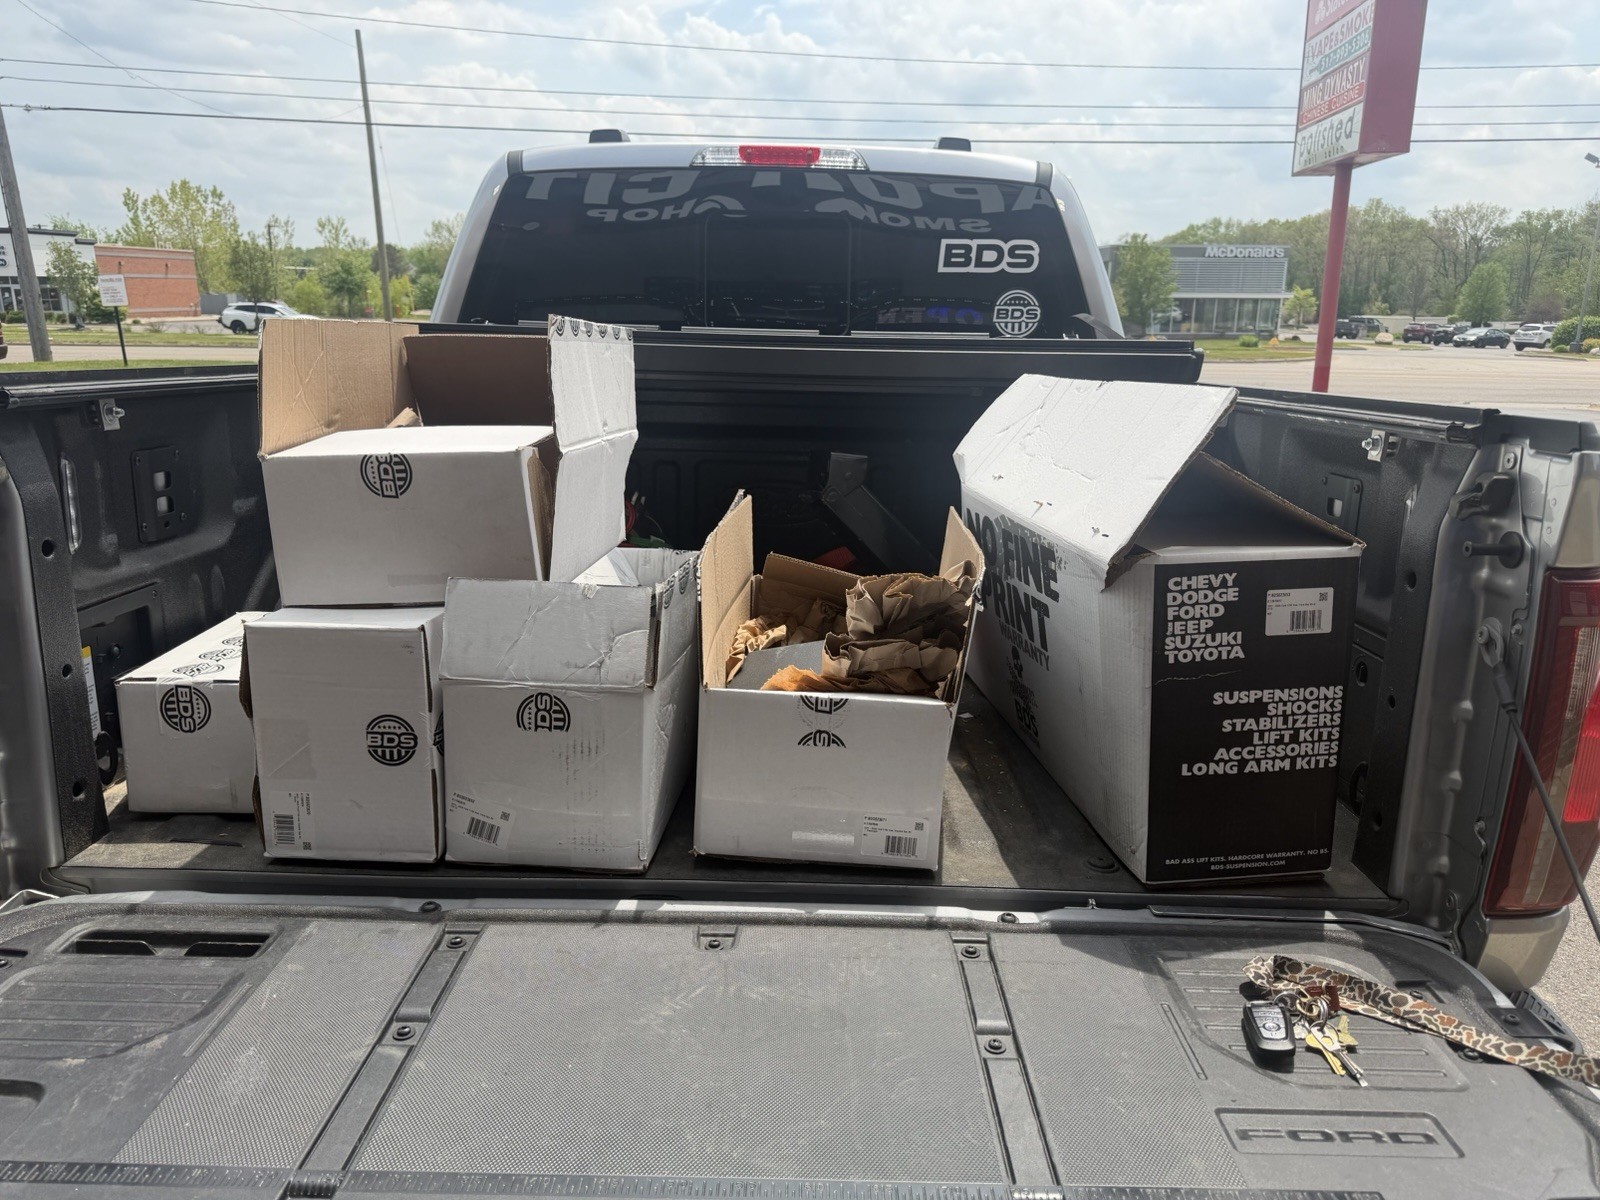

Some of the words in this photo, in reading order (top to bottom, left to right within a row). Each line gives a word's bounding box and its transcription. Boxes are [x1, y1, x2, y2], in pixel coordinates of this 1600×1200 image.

[1303, 82, 1323, 113] MING
[1324, 57, 1365, 100] DYNASTY
[1303, 103, 1329, 123] CHINESE
[1331, 86, 1360, 109] CUISINE
[1300, 108, 1356, 165] polished
[938, 239, 1040, 273] BDS
[1204, 246, 1285, 258] McDonald's
[993, 306, 1040, 322] BDS
[966, 508, 997, 567] NO
[1001, 527, 1060, 603] FINE
[1168, 573, 1237, 591] CHEVY
[1167, 588, 1239, 606] DODGE
[983, 569, 1050, 653] PRINT
[1167, 603, 1225, 621] FORD
[1166, 619, 1214, 635] JEEP
[999, 619, 1050, 671] WARRANTY
[1165, 631, 1242, 650] SUZUKI
[1165, 646, 1245, 664] TOYOTA
[1213, 686, 1344, 705] SUSPENSIONS
[175, 685, 196, 733] BDS
[1267, 699, 1342, 716] SHOCKS
[1015, 698, 1039, 738] BDS
[1222, 713, 1341, 732] STABILIZERS
[366, 731, 418, 749] BDS
[1253, 730, 1294, 745] LIFT
[1299, 727, 1340, 742] KITS
[1213, 741, 1339, 761] ACCESSORIES
[1181, 762, 1239, 776] LONG
[1243, 758, 1290, 774] ARM
[1296, 755, 1338, 770] KITS
[1228, 853, 1264, 861] HARDCORE
[1266, 850, 1306, 859] WARRANTY.
[1211, 860, 1286, 871] BDS-SUSPENSION.COM
[1235, 1128, 1439, 1145] FORD
